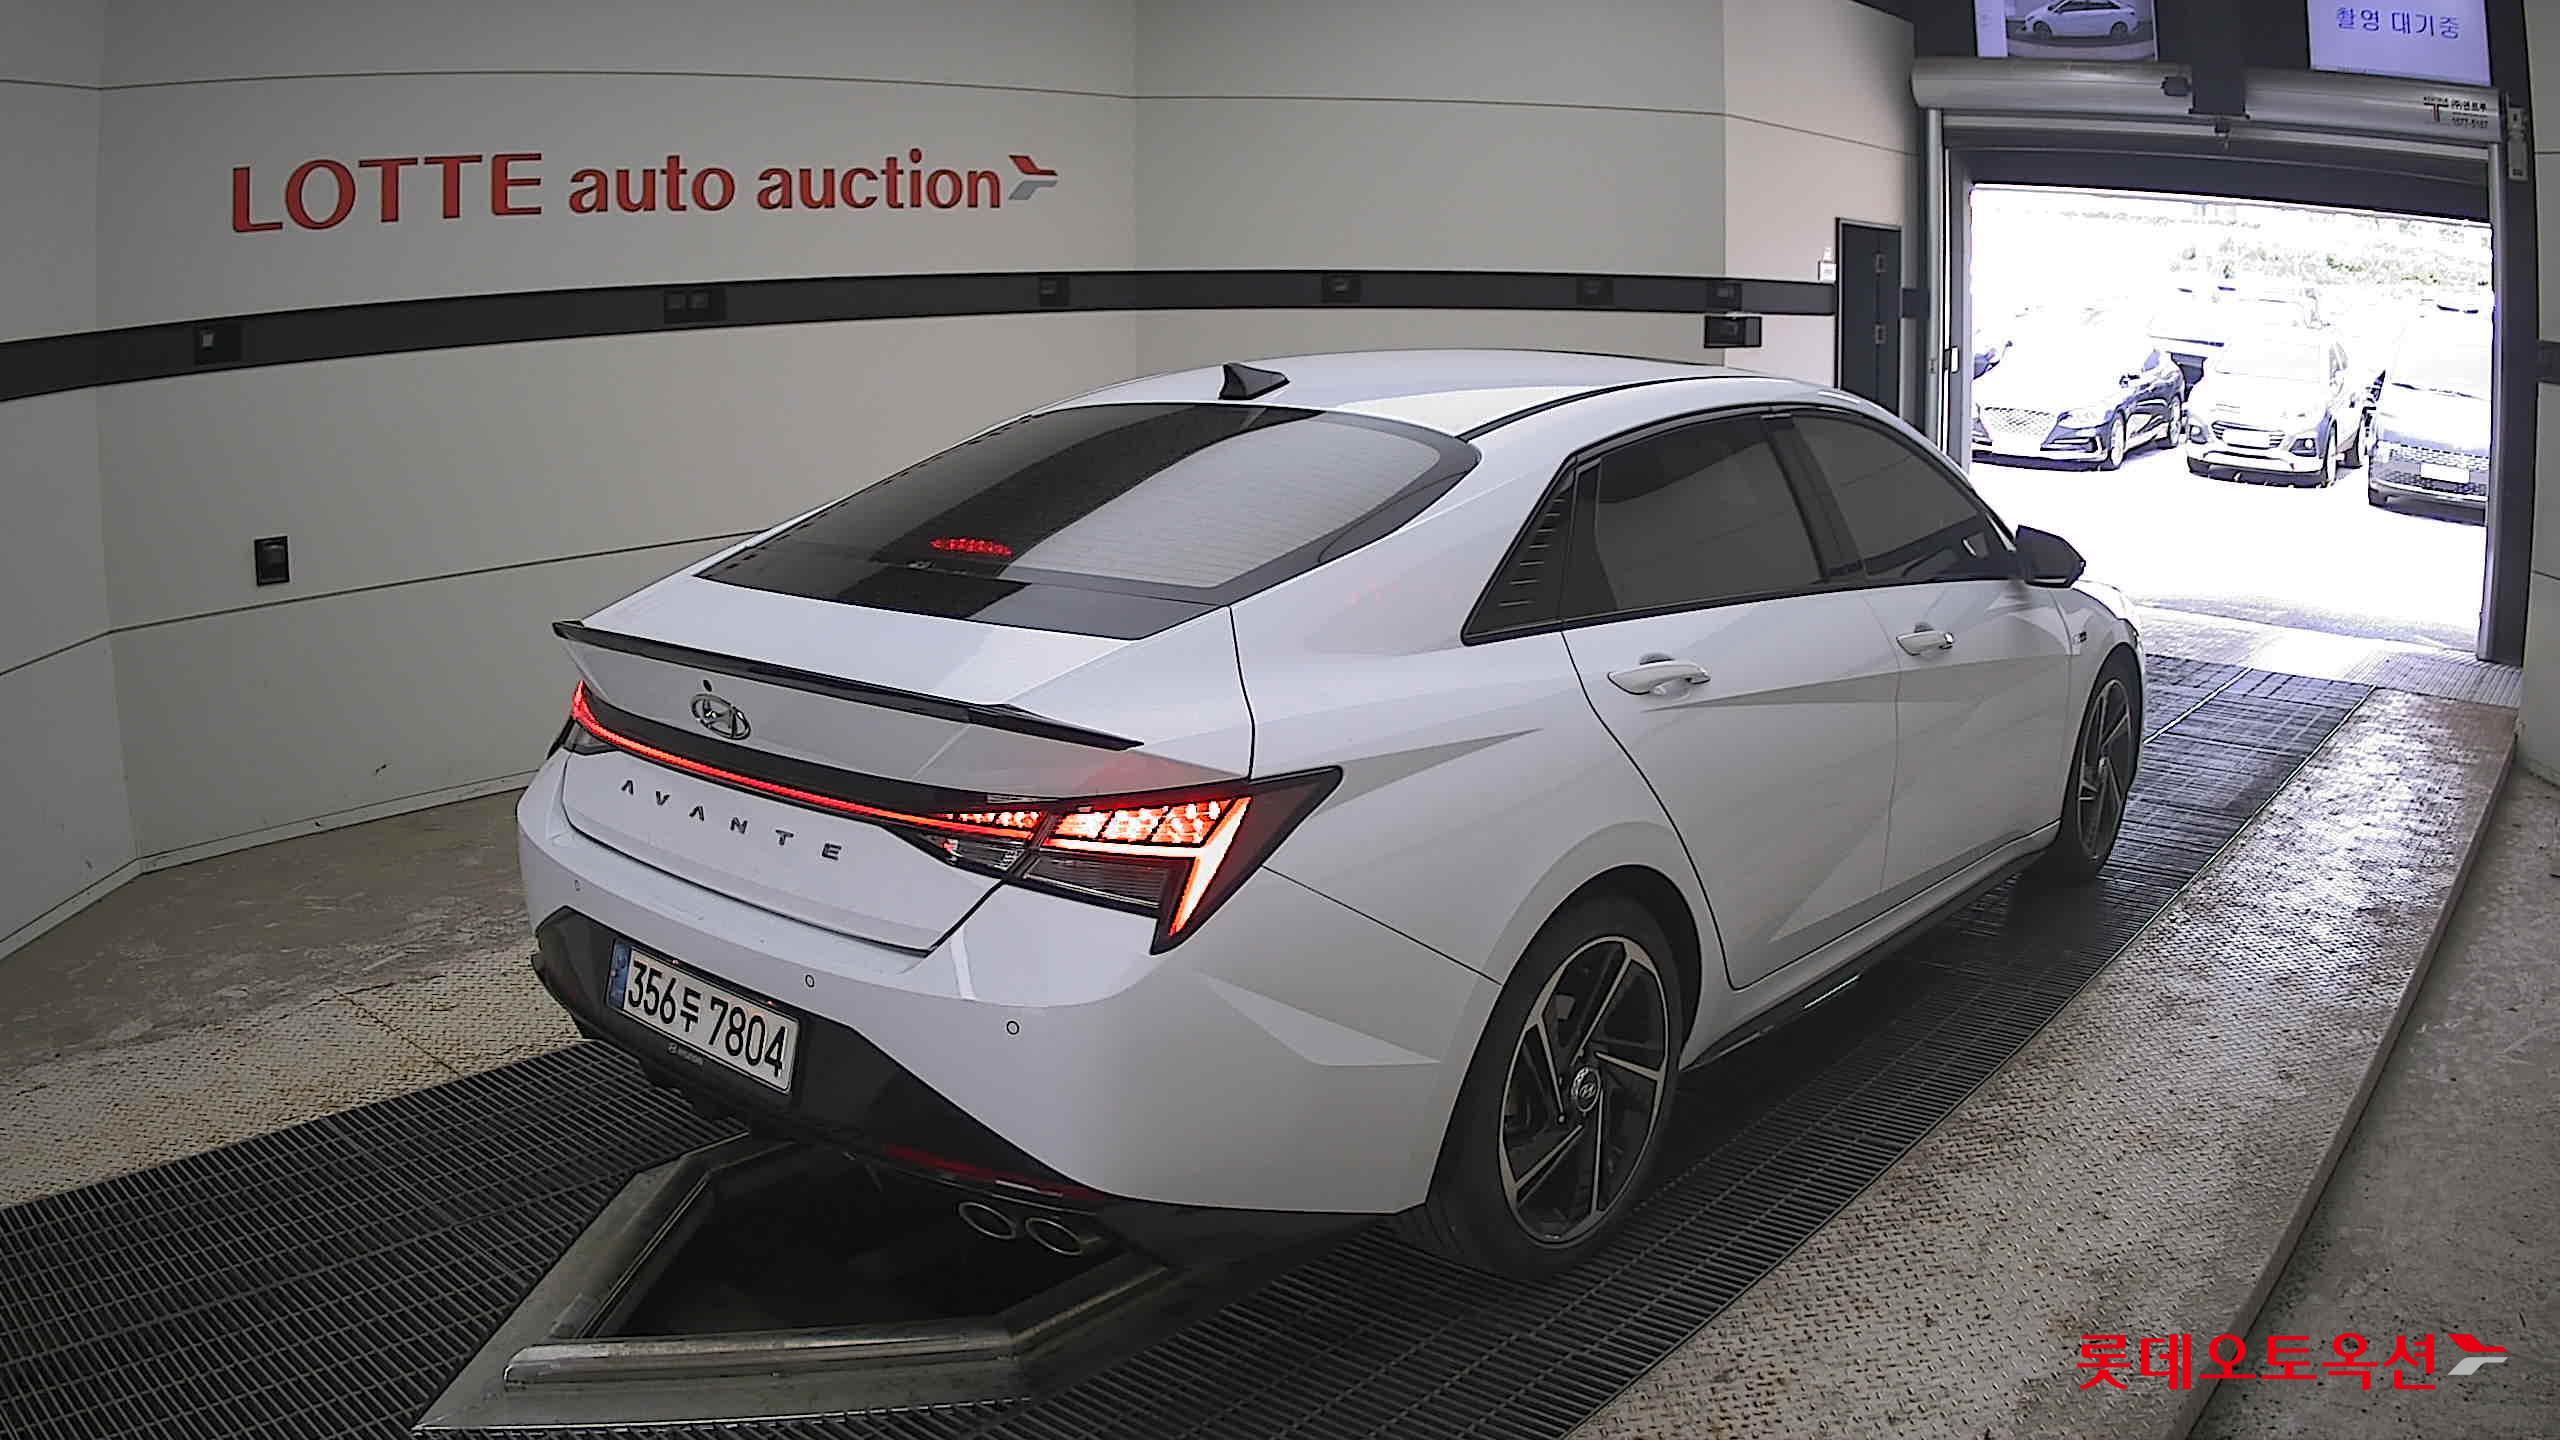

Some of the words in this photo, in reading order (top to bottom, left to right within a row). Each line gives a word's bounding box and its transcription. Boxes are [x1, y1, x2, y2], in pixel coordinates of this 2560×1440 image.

[2336, 7, 2380, 32] 촬영
[2391, 12, 2459, 39] 대기중
[232, 153, 542, 233] LOTTE
[568, 155, 736, 214] auto
[756, 148, 1001, 210] auction
[621, 779, 842, 861] AVANTE
[627, 959, 702, 1033] 356두
[708, 996, 786, 1077] 7804
